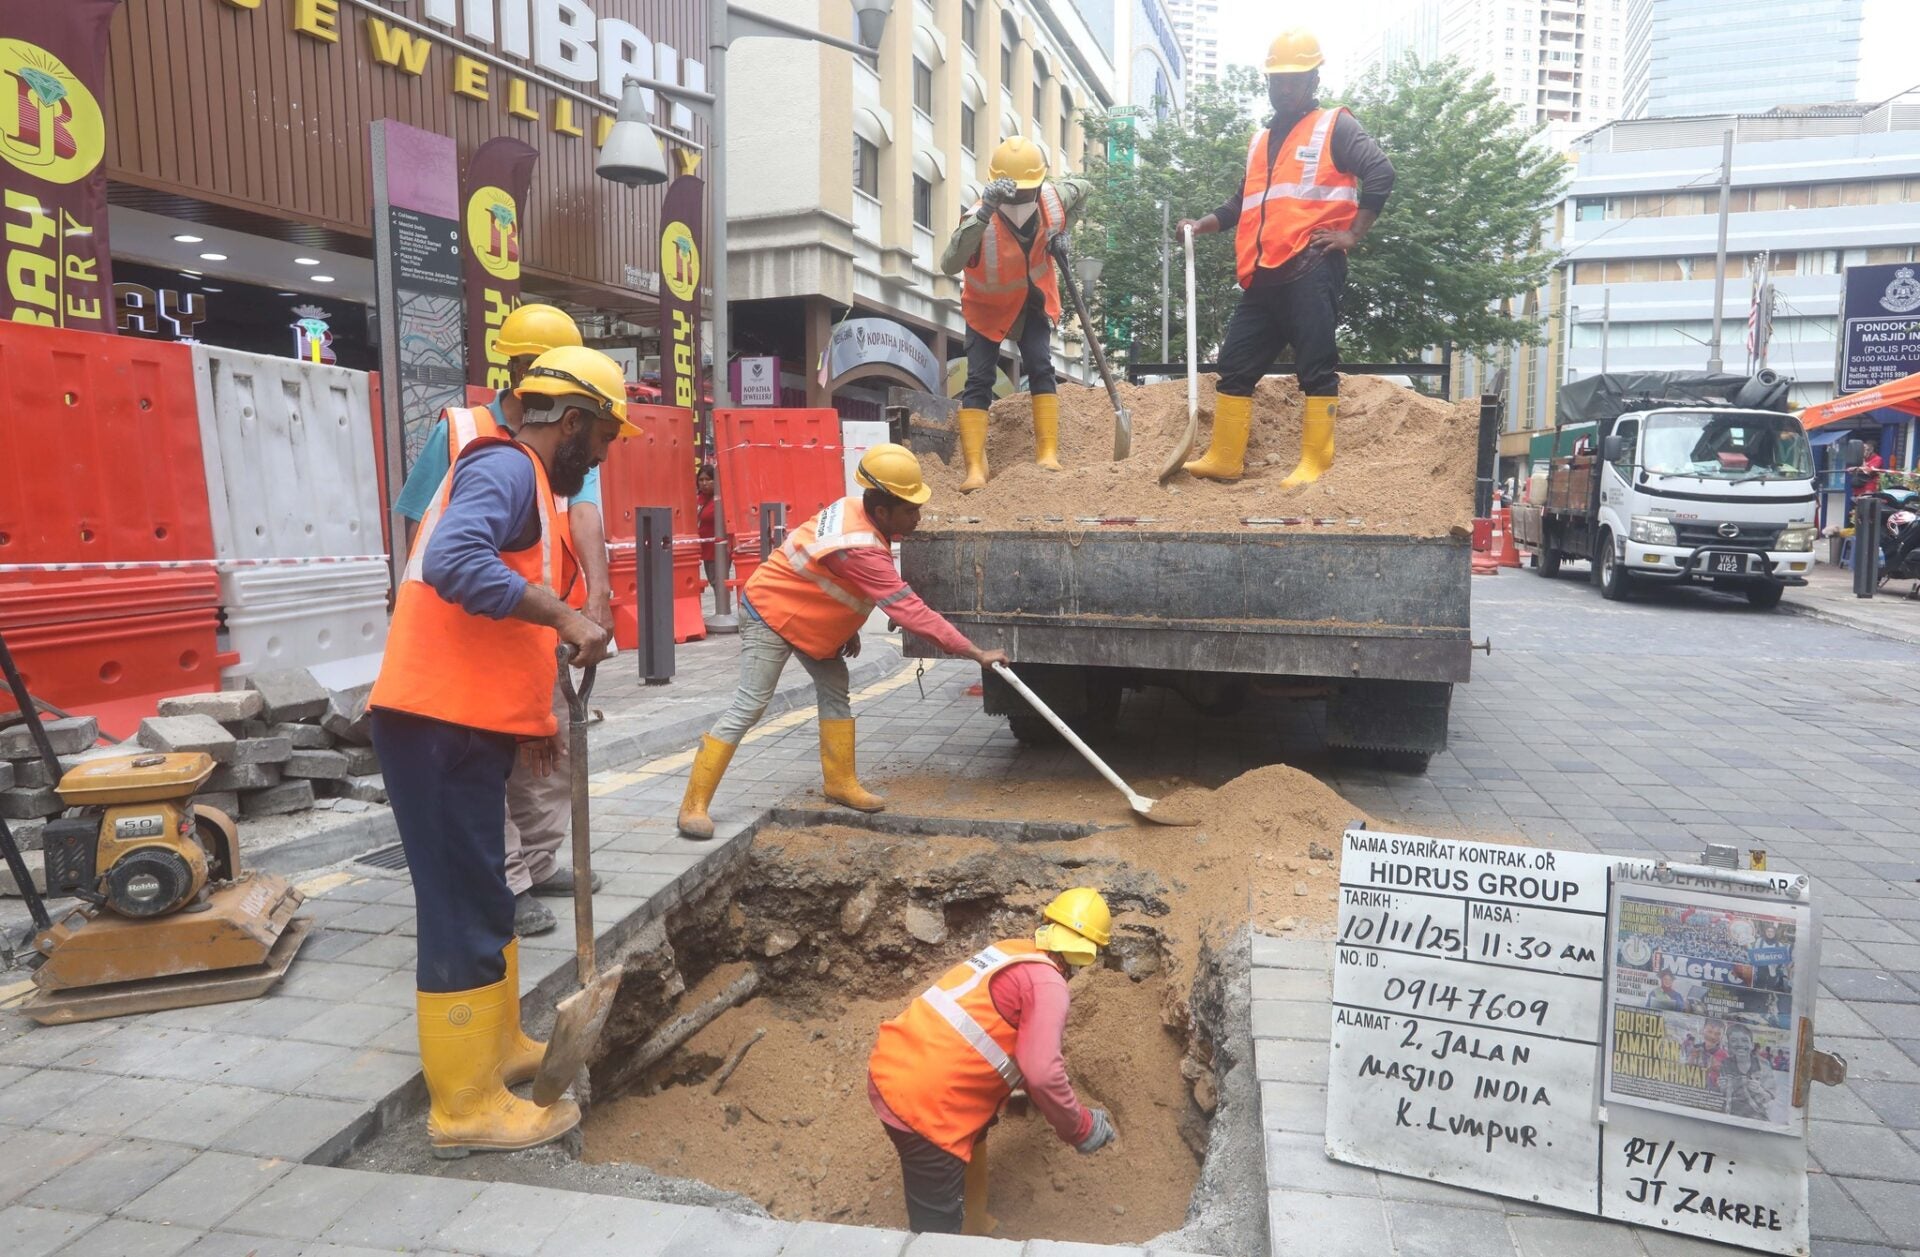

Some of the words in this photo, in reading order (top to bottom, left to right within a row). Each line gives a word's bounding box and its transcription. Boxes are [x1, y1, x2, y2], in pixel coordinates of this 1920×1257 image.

[867, 332, 898, 349] KOPATHA
[1856, 322, 1907, 332] PONDOK
[1862, 332, 1906, 342] MASJID
[673, 309, 692, 407] BAY
[1864, 345, 1899, 354] (POLIS
[1877, 354, 1907, 362] KUALA
[743, 385, 771, 393] KOPATHA
[1717, 563, 1738, 572] 4122
[1720, 555, 1737, 564] VKA
[1350, 836, 1388, 854] NAMA
[1391, 839, 1455, 860] SYARIKAT
[1459, 846, 1556, 871] KONTRAKOR
[128, 882, 159, 891] Robin
[1370, 862, 1469, 891] HIDRUS
[1478, 872, 1579, 903] GROUP
[1343, 912, 1461, 952] 10/11/25
[1340, 950, 1362, 967] NO.
[1482, 933, 1551, 960] 11:30
[1661, 954, 1745, 985] Metro
[1384, 977, 1549, 1026] 09147609
[1337, 1009, 1391, 1030] ALAMAT
[1615, 1010, 1635, 1032] IBU
[1636, 1012, 1665, 1038] REDA
[1432, 1031, 1530, 1065] JALAN
[1615, 1031, 1681, 1061] TAMATKAN
[1359, 1055, 1454, 1091] MASJID
[1474, 1076, 1550, 1106] INDIA
[1613, 1052, 1668, 1082] BANTUAN
[1668, 1061, 1709, 1089] HAYAT
[1625, 1177, 1667, 1206] JT
[1673, 1187, 1782, 1231] ZAKREE
